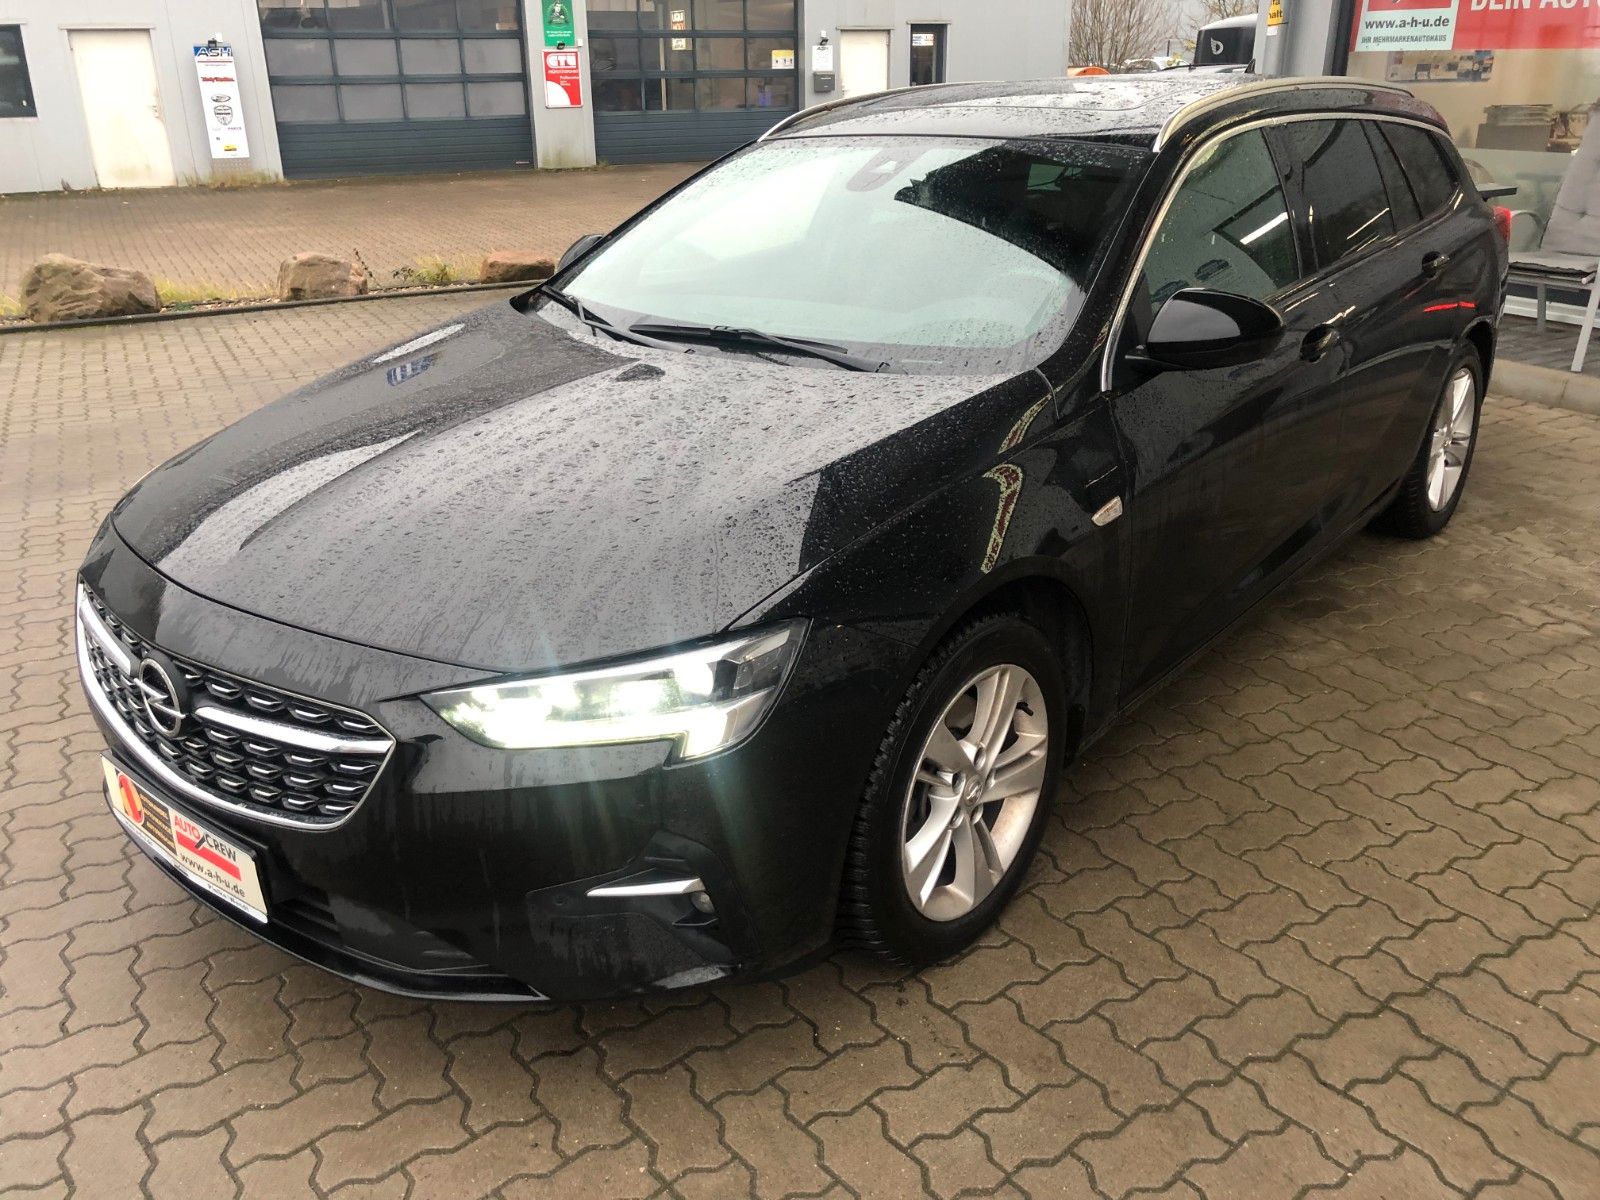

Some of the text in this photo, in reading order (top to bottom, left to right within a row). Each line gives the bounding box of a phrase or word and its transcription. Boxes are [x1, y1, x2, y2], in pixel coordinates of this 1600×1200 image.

[1365, 15, 1450, 29] www.a-h-u.de
[197, 46, 233, 57] ASH
[174, 815, 201, 840] AUTO
[205, 833, 236, 862] CREW
[180, 852, 246, 897] www.a-h-u.de
